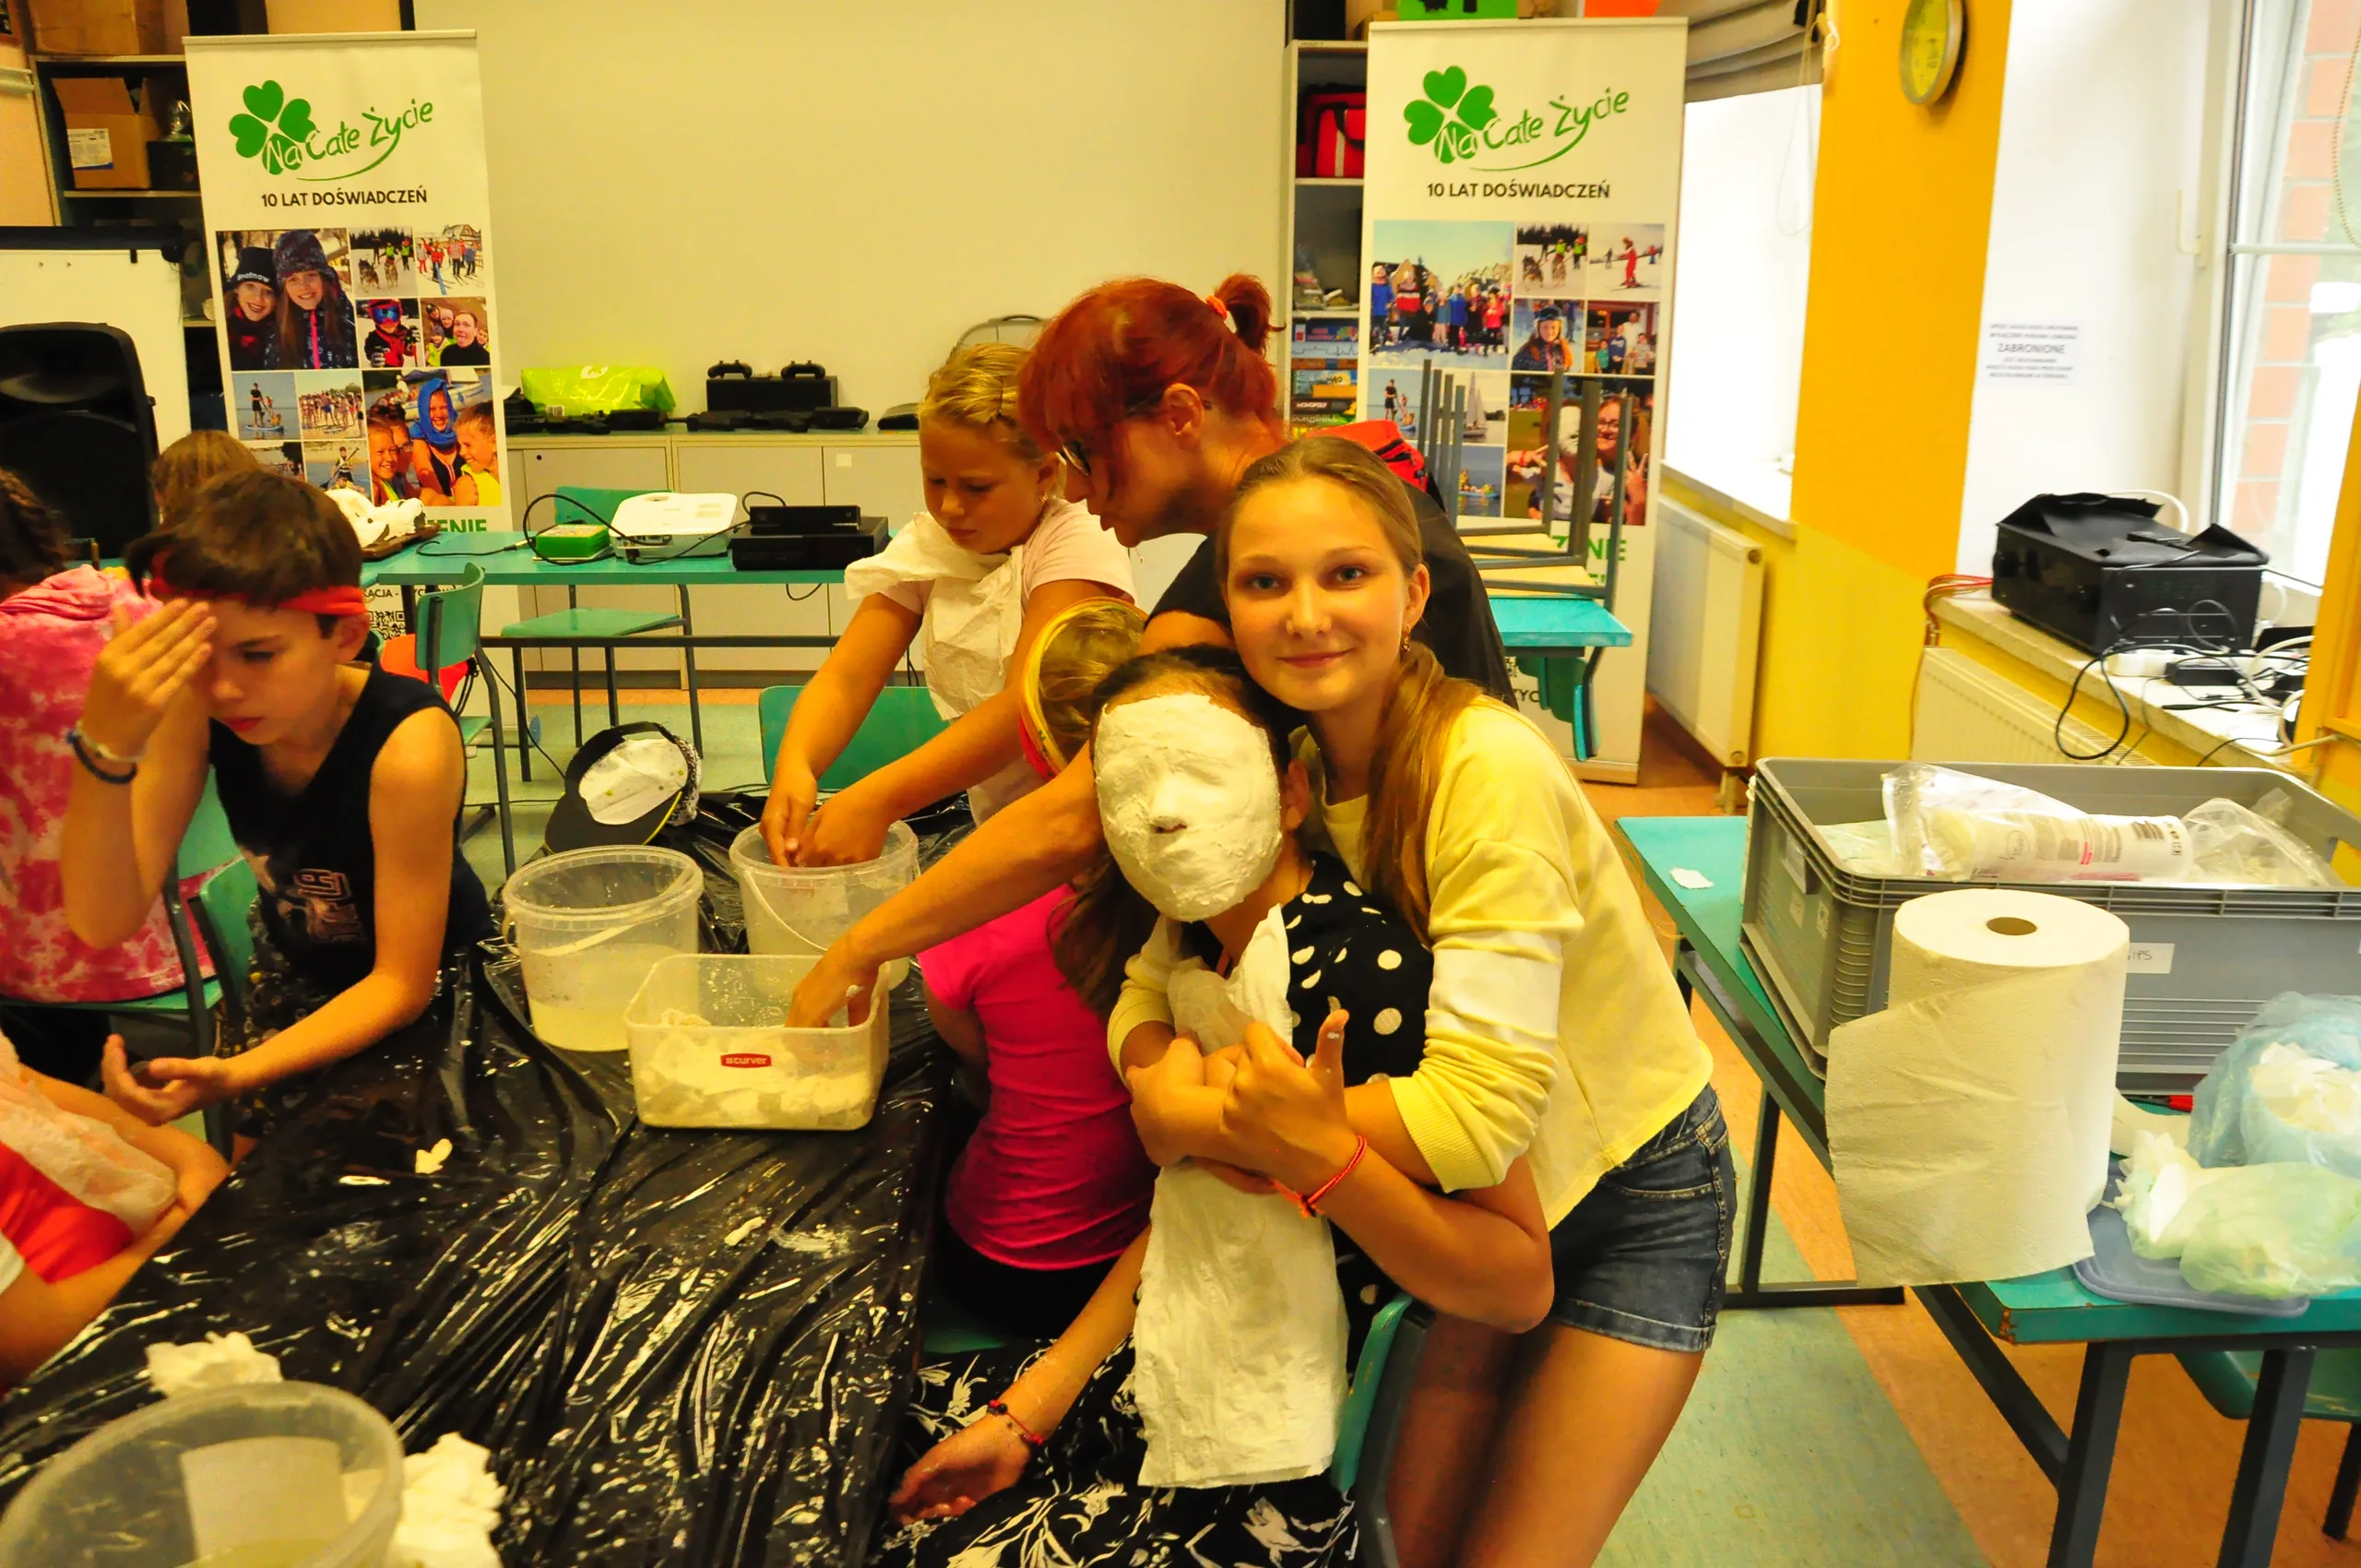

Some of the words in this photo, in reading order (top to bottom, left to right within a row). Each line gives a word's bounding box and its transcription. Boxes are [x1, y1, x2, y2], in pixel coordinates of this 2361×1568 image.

[266, 138, 303, 172] Na
[305, 120, 361, 160] Całe
[362, 98, 433, 149] Życie
[1437, 126, 1477, 160] Na
[1483, 109, 1544, 149] Całe
[1548, 87, 1630, 140] Życie
[261, 193, 278, 208] 10
[281, 193, 308, 207] LAT
[312, 184, 428, 207] DOŚWIADCZEŃ
[1427, 183, 1444, 197] 10
[1449, 183, 1479, 197] LAT
[1482, 179, 1611, 199] DOŚWIADCZEŃ
[2128, 950, 2153, 961] IPS
